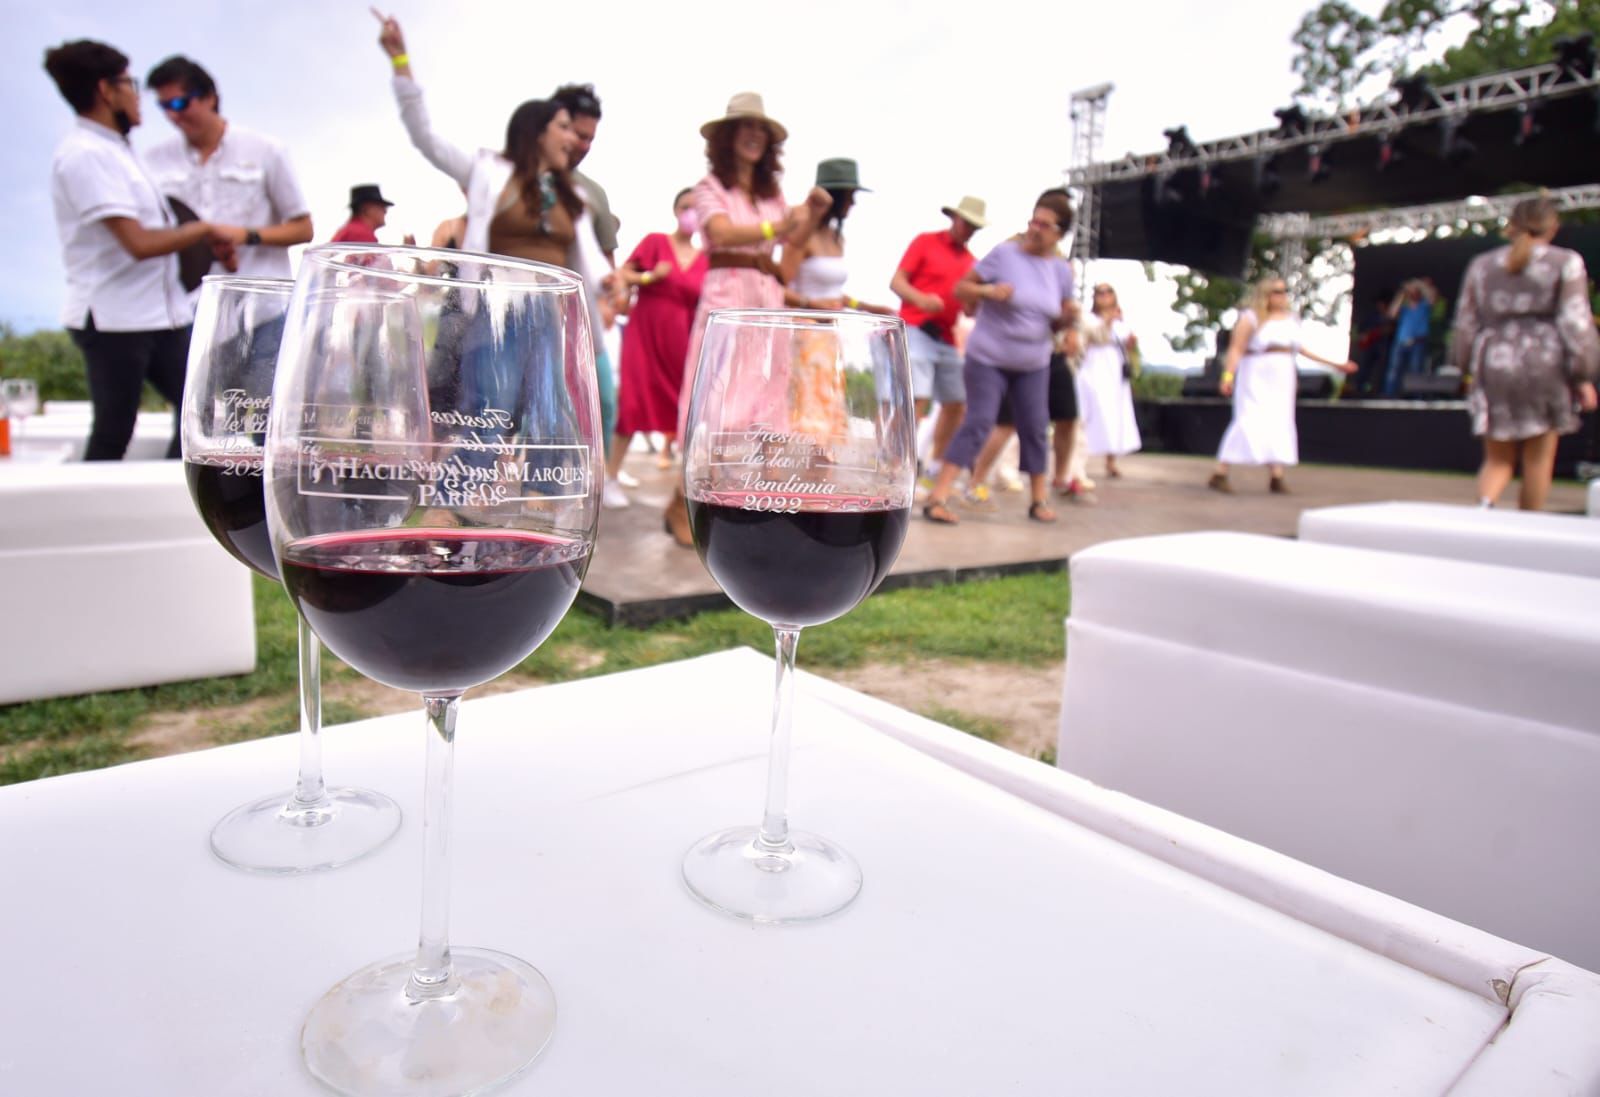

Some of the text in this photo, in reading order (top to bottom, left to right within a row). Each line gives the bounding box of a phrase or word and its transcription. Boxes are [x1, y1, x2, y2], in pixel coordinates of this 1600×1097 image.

[223, 388, 273, 409] Fiest
[221, 459, 265, 477] 202
[740, 471, 837, 495] Vendimia
[741, 494, 802, 514] 2022
